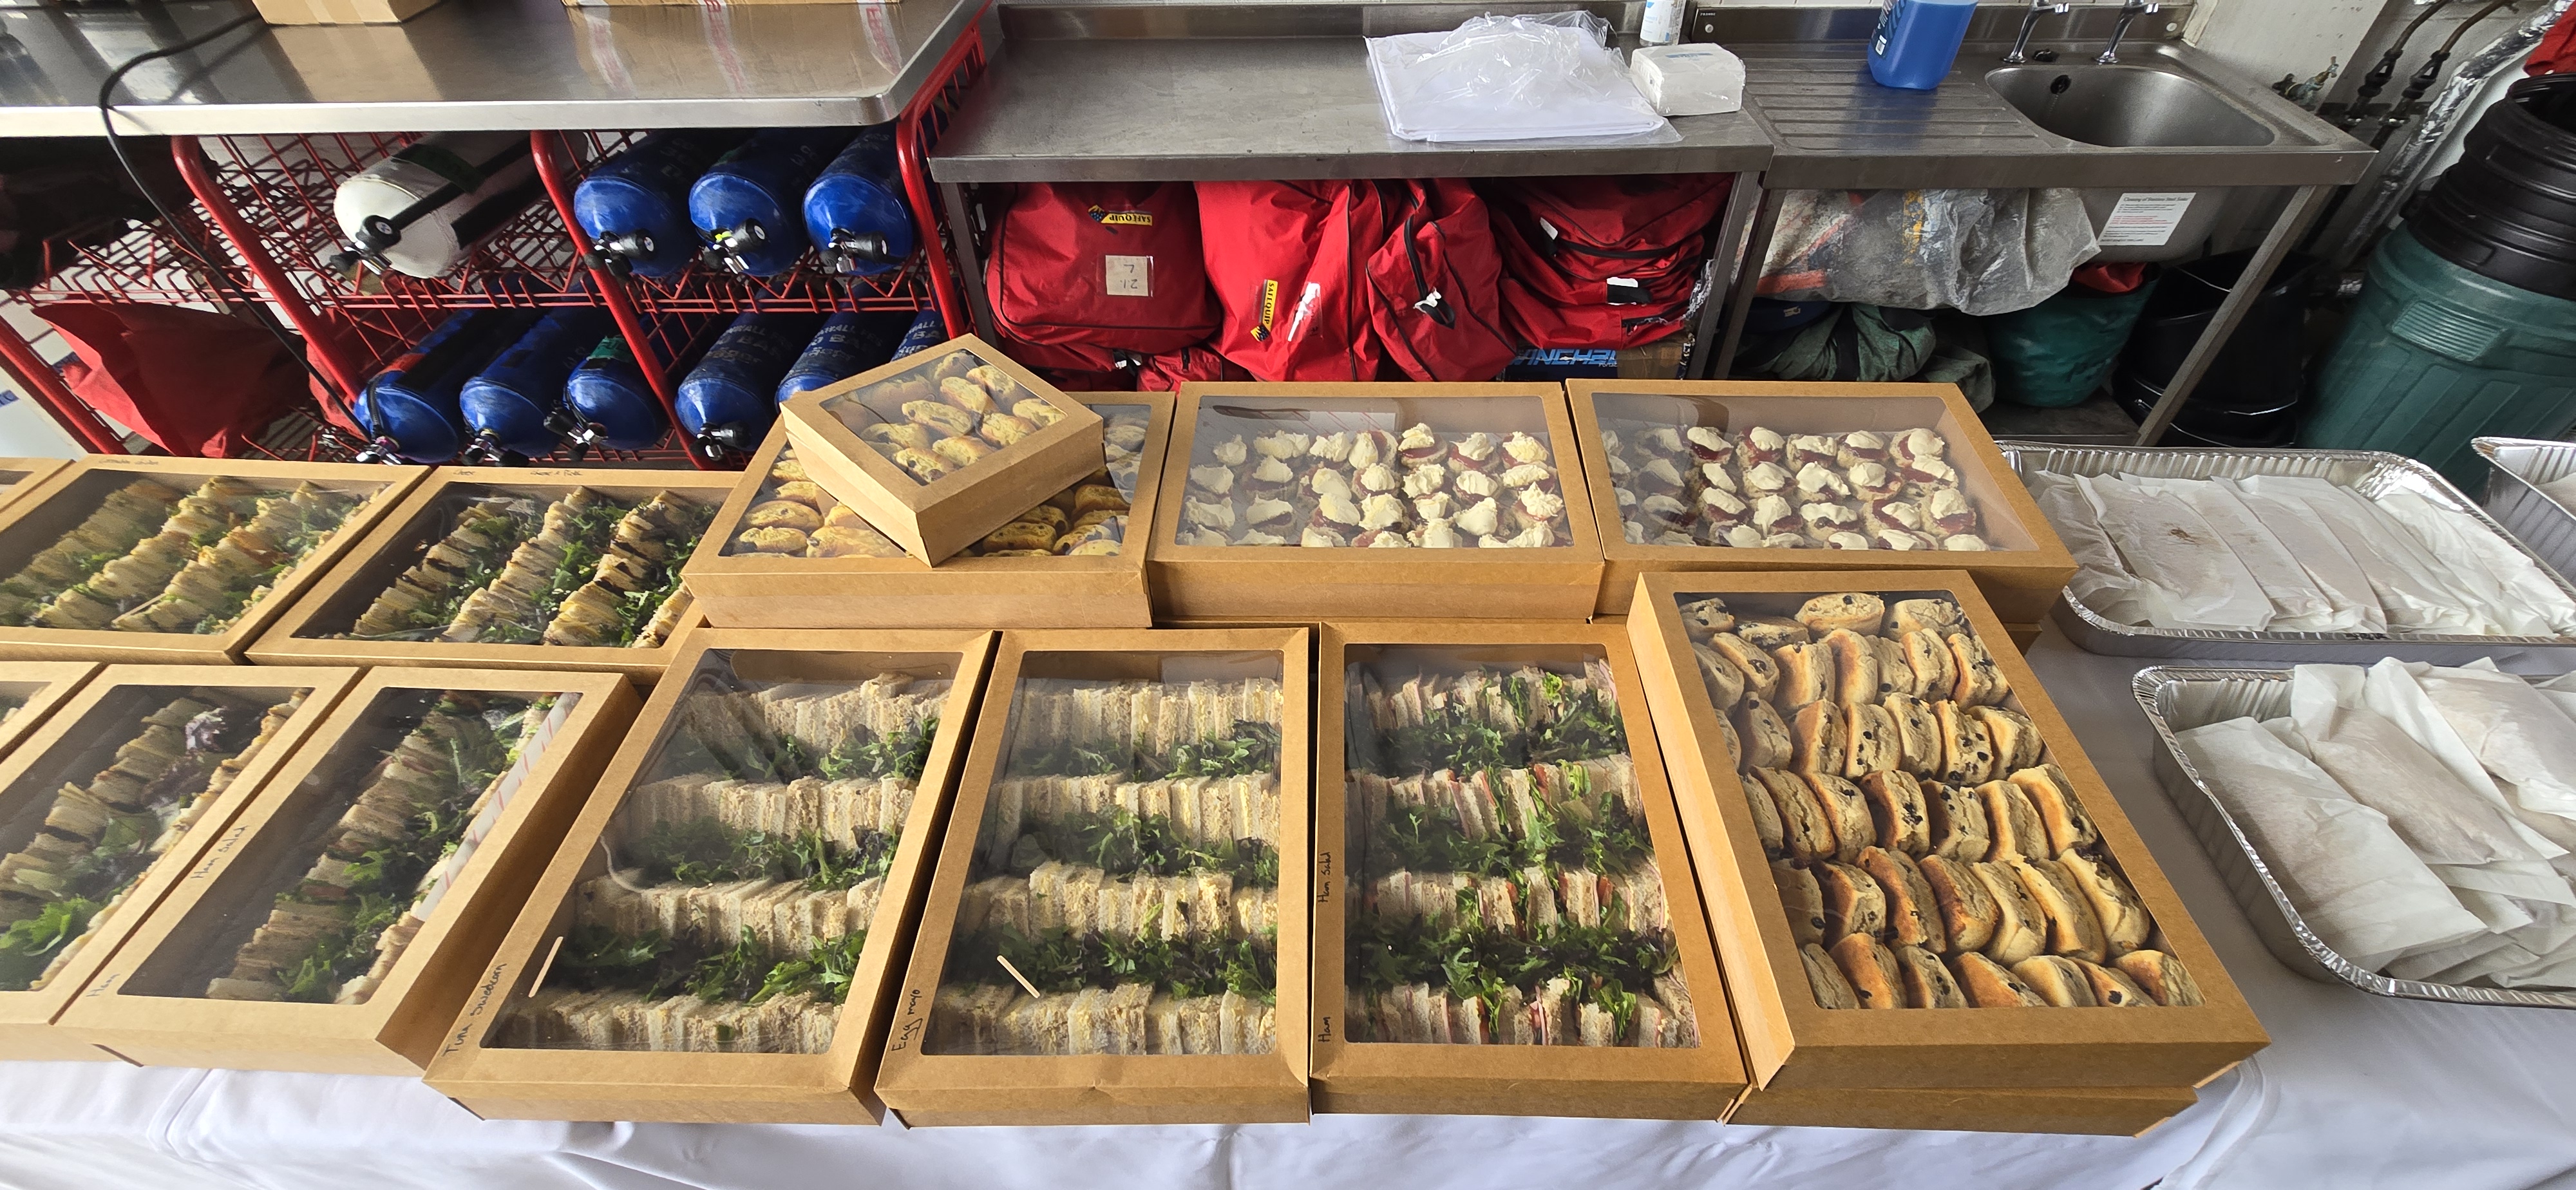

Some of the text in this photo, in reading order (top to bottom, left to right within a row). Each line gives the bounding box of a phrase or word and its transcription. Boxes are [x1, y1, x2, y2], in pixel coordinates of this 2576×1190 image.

[1109, 214, 1151, 223] SAFEQUIP
[1264, 283, 1274, 325] SAFEQUIP
[190, 857, 220, 878] Ham
[1317, 881, 1331, 902] Ham
[86, 973, 120, 997] Ham
[891, 989, 923, 1051] Egg mayo
[1318, 1017, 1331, 1043] Ham
